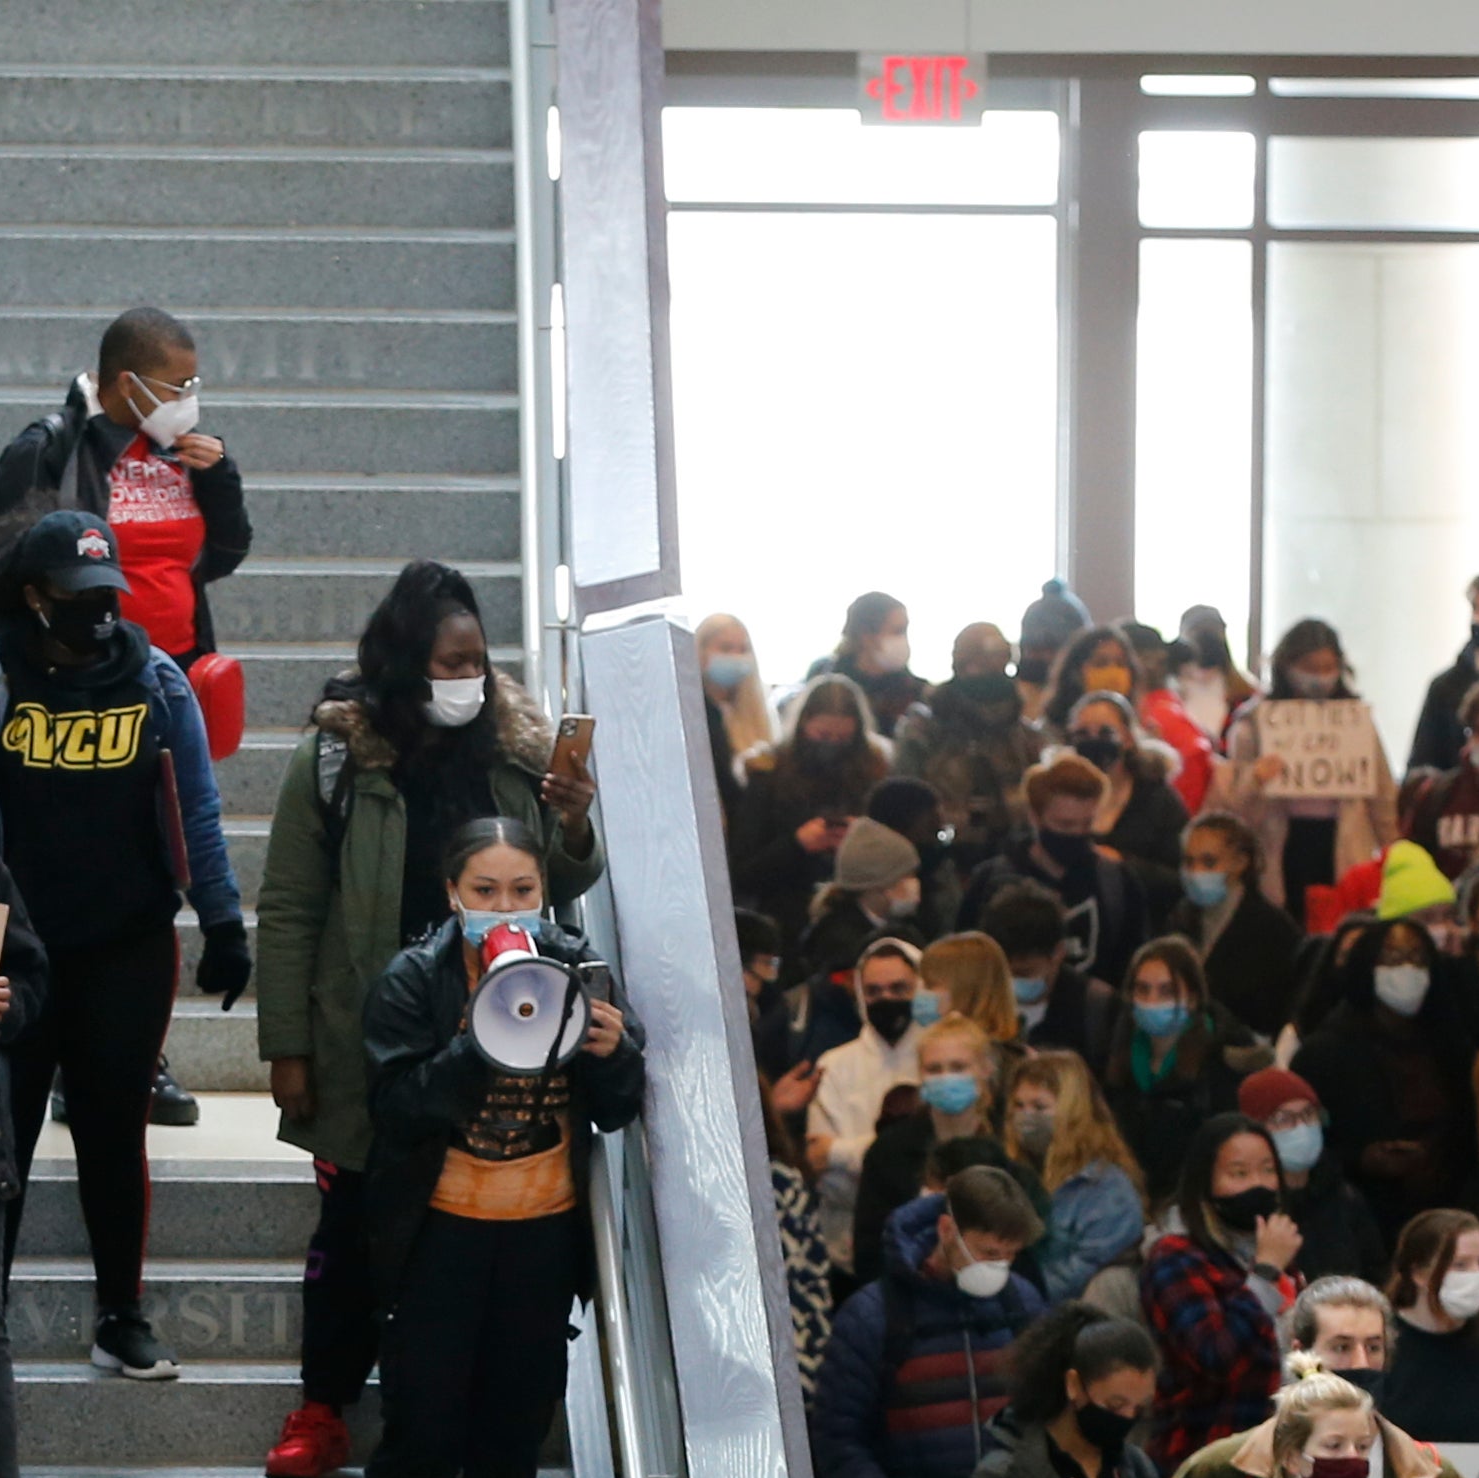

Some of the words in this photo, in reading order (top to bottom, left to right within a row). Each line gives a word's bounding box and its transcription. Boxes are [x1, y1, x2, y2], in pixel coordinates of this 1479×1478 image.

[882, 56, 968, 121] EXIT
[2, 702, 148, 769] VCU
[1280, 758, 1369, 788] NOW!
